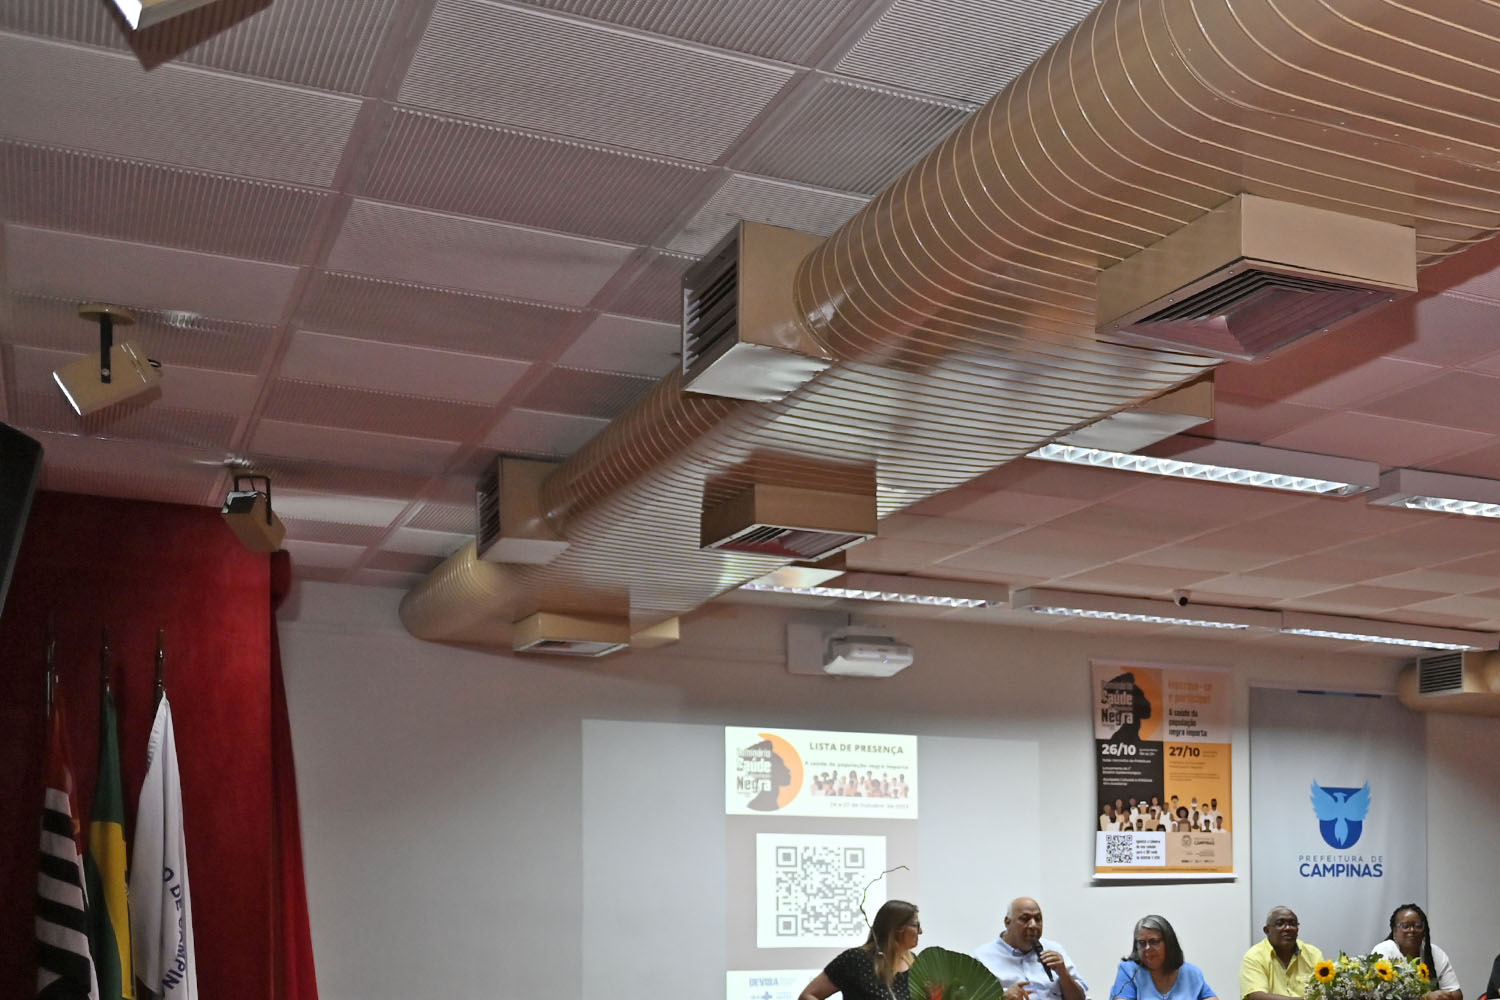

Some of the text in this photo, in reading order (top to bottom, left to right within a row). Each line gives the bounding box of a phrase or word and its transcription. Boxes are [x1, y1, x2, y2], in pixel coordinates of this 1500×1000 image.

[1101, 708, 1134, 726] Negra
[809, 742, 904, 755] LISTA DE PRESENÇA
[1101, 742, 1136, 756] 26/10
[1169, 745, 1200, 758] 27/10
[1299, 863, 1384, 878] CAMPINAS
